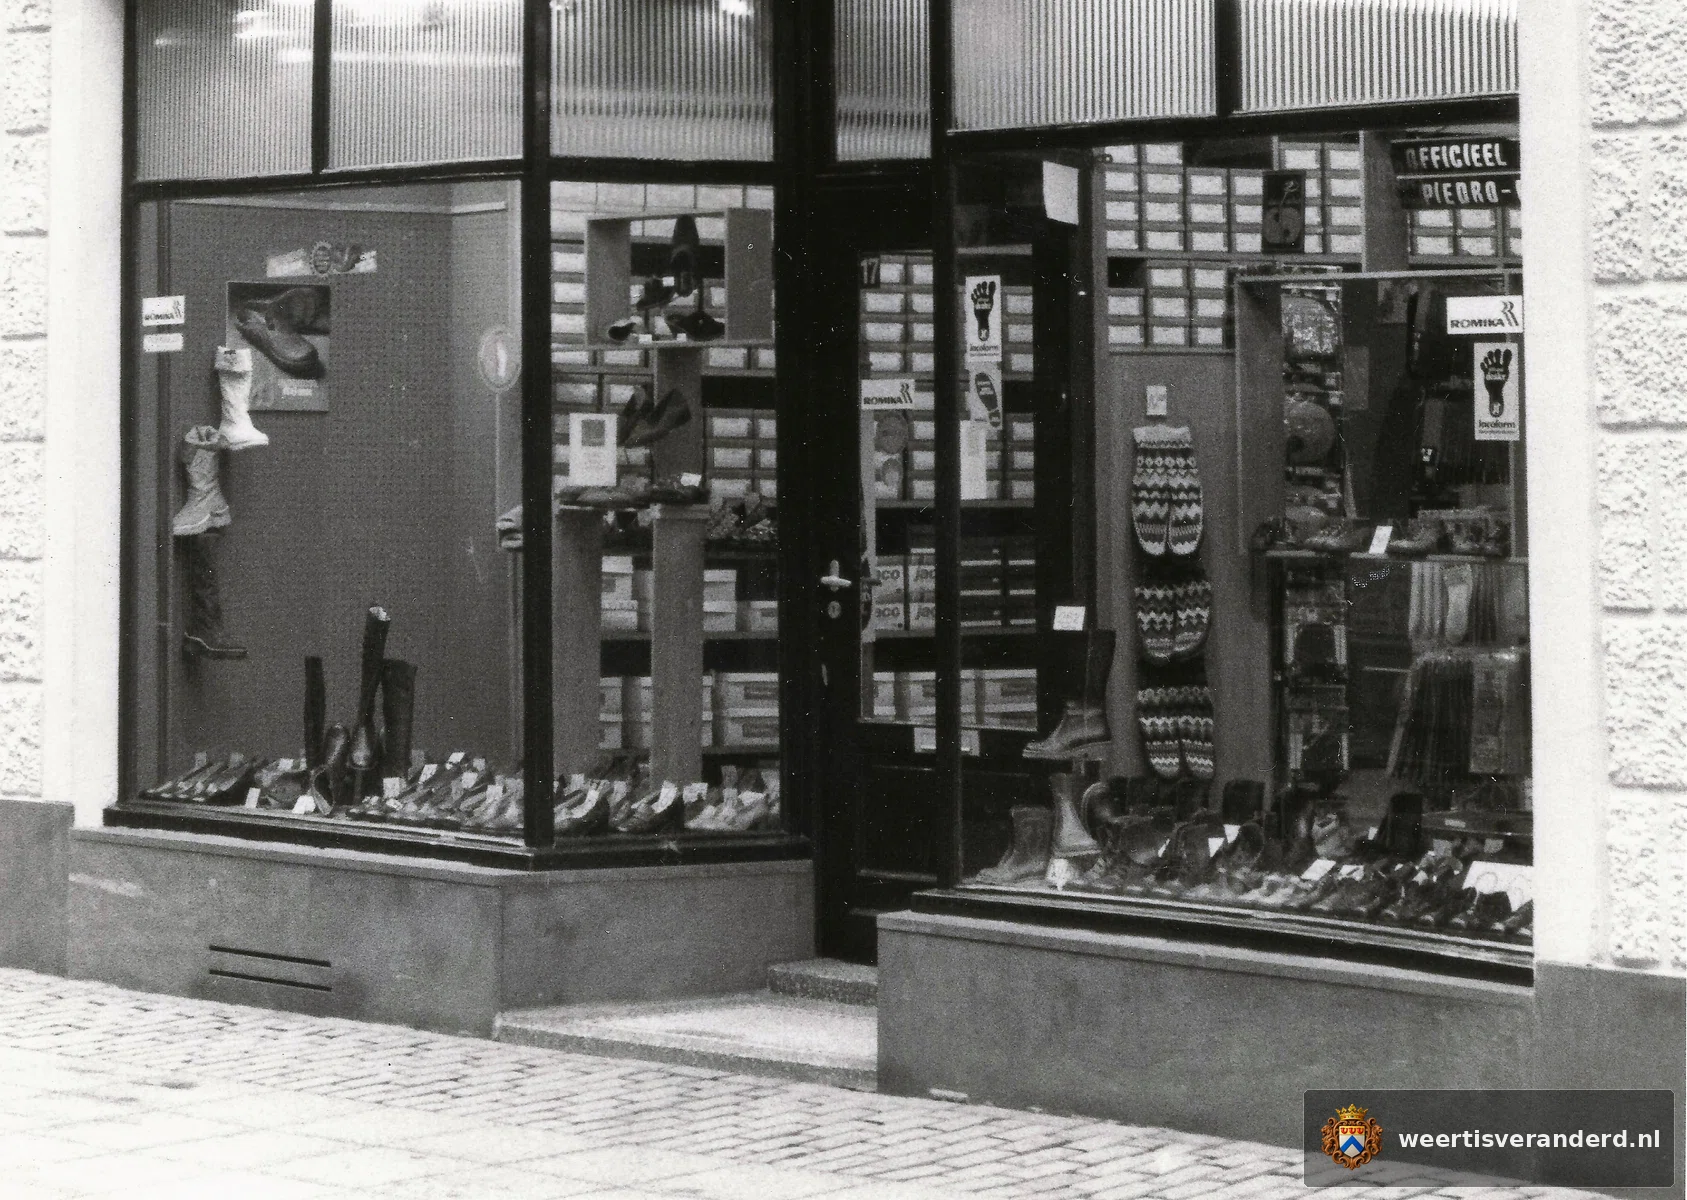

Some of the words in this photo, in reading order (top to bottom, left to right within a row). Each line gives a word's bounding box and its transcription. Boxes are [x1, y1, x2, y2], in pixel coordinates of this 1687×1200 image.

[1405, 142, 1507, 169] OFFICIEEL
[1422, 180, 1521, 205] PIEDRO-
[860, 257, 880, 284] 17
[1450, 318, 1505, 329] ROMIKA
